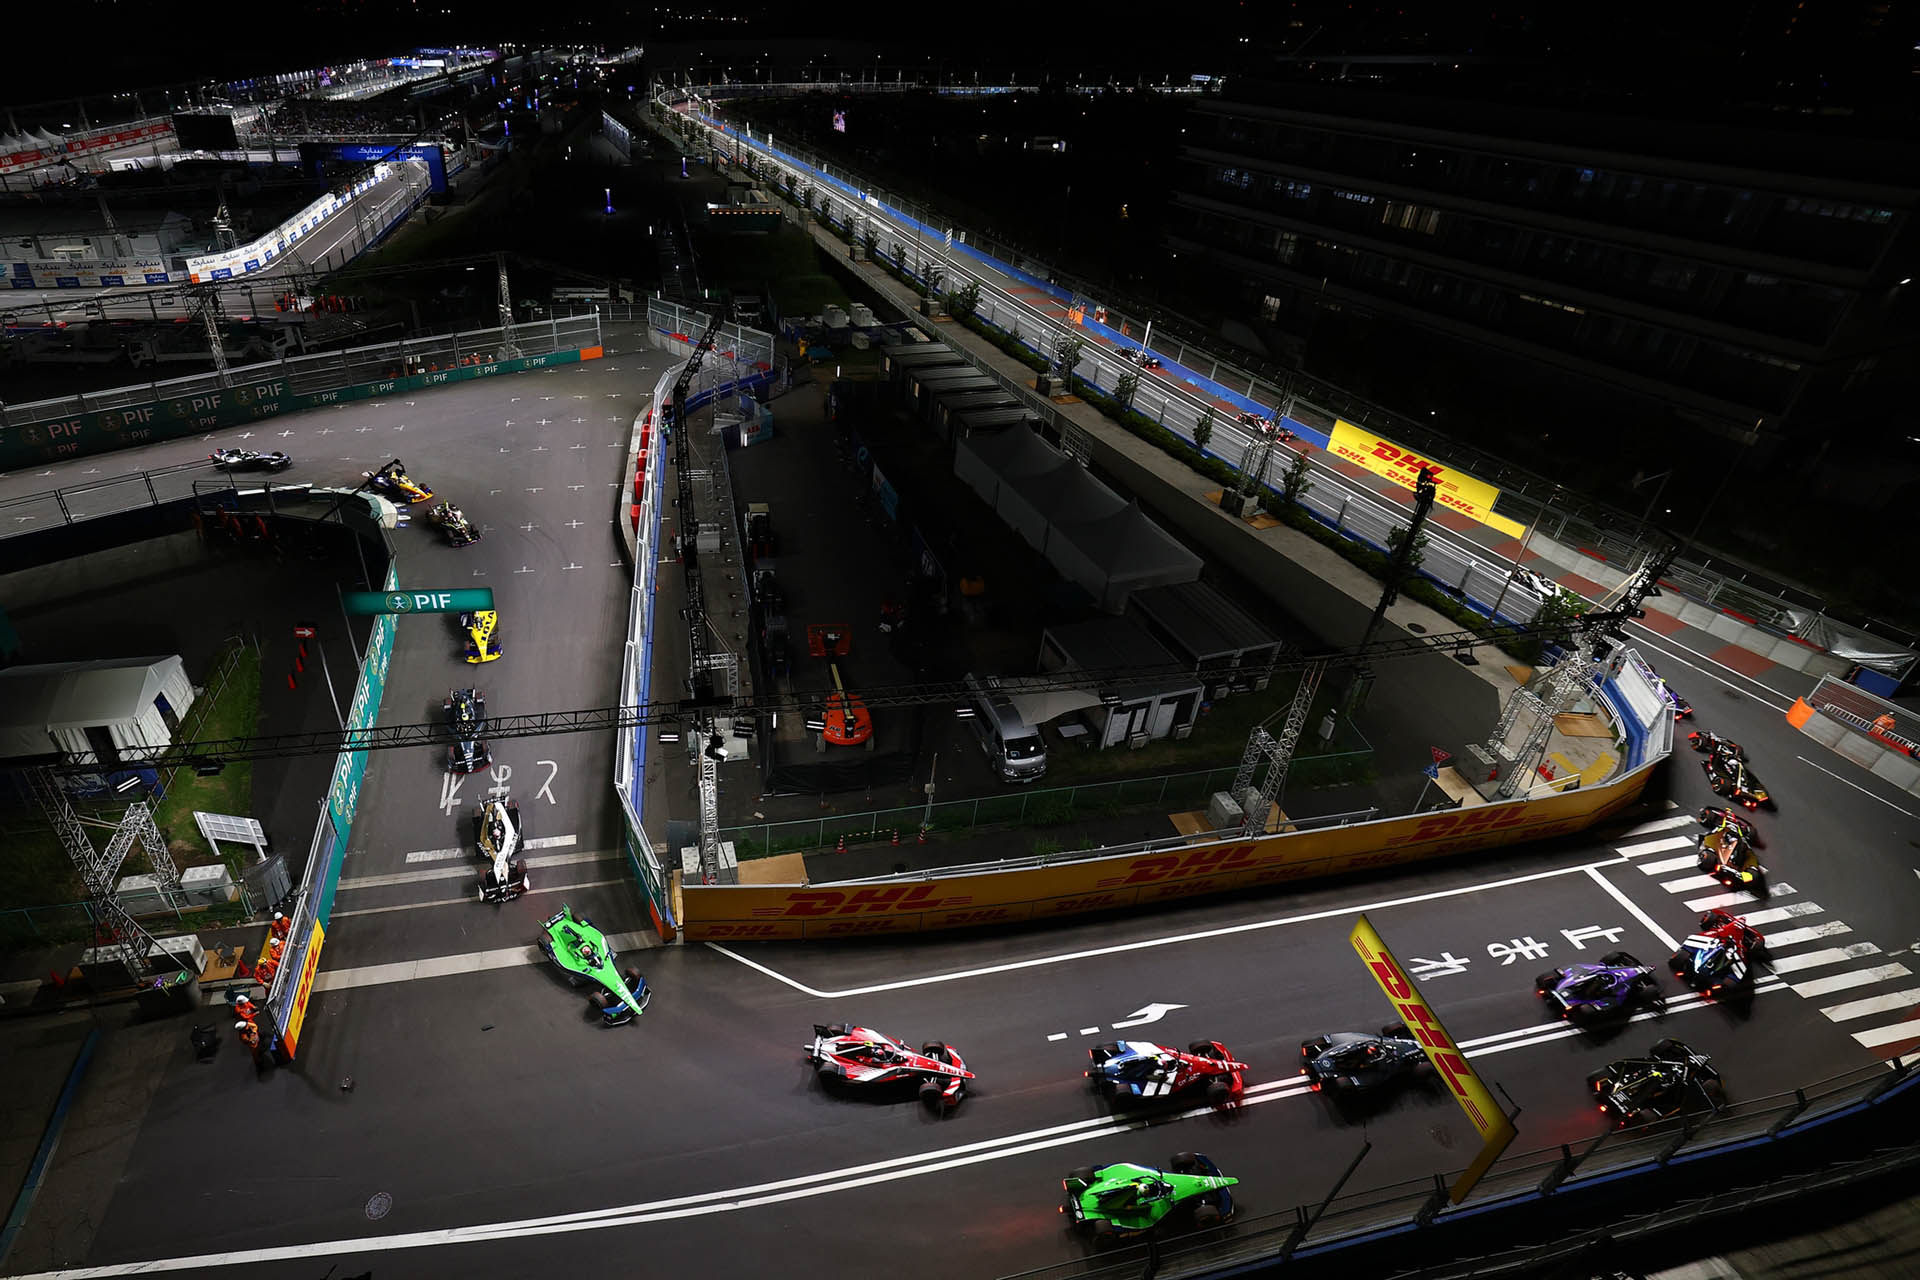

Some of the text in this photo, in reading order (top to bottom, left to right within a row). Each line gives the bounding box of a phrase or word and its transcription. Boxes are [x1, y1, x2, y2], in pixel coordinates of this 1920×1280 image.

[255, 382, 284, 400] PIF
[192, 394, 221, 413] PIF
[122, 407, 154, 425] PIF
[47, 419, 82, 440] PIF
[1336, 446, 1367, 465] DHL
[1371, 442, 1445, 485] DHL
[1439, 494, 1478, 515] DHL
[413, 593, 451, 610] PIF
[358, 676, 371, 717] PIF
[1408, 806, 1528, 841] DHL
[1124, 846, 1257, 884] DHL
[784, 885, 943, 916] DHL
[828, 920, 898, 934] DHL
[946, 909, 1010, 925] DHL
[706, 925, 778, 937] DHL
[1407, 925, 1625, 982] 止まれ
[297, 945, 318, 1016] DHL
[1369, 951, 1471, 1097] DHL
